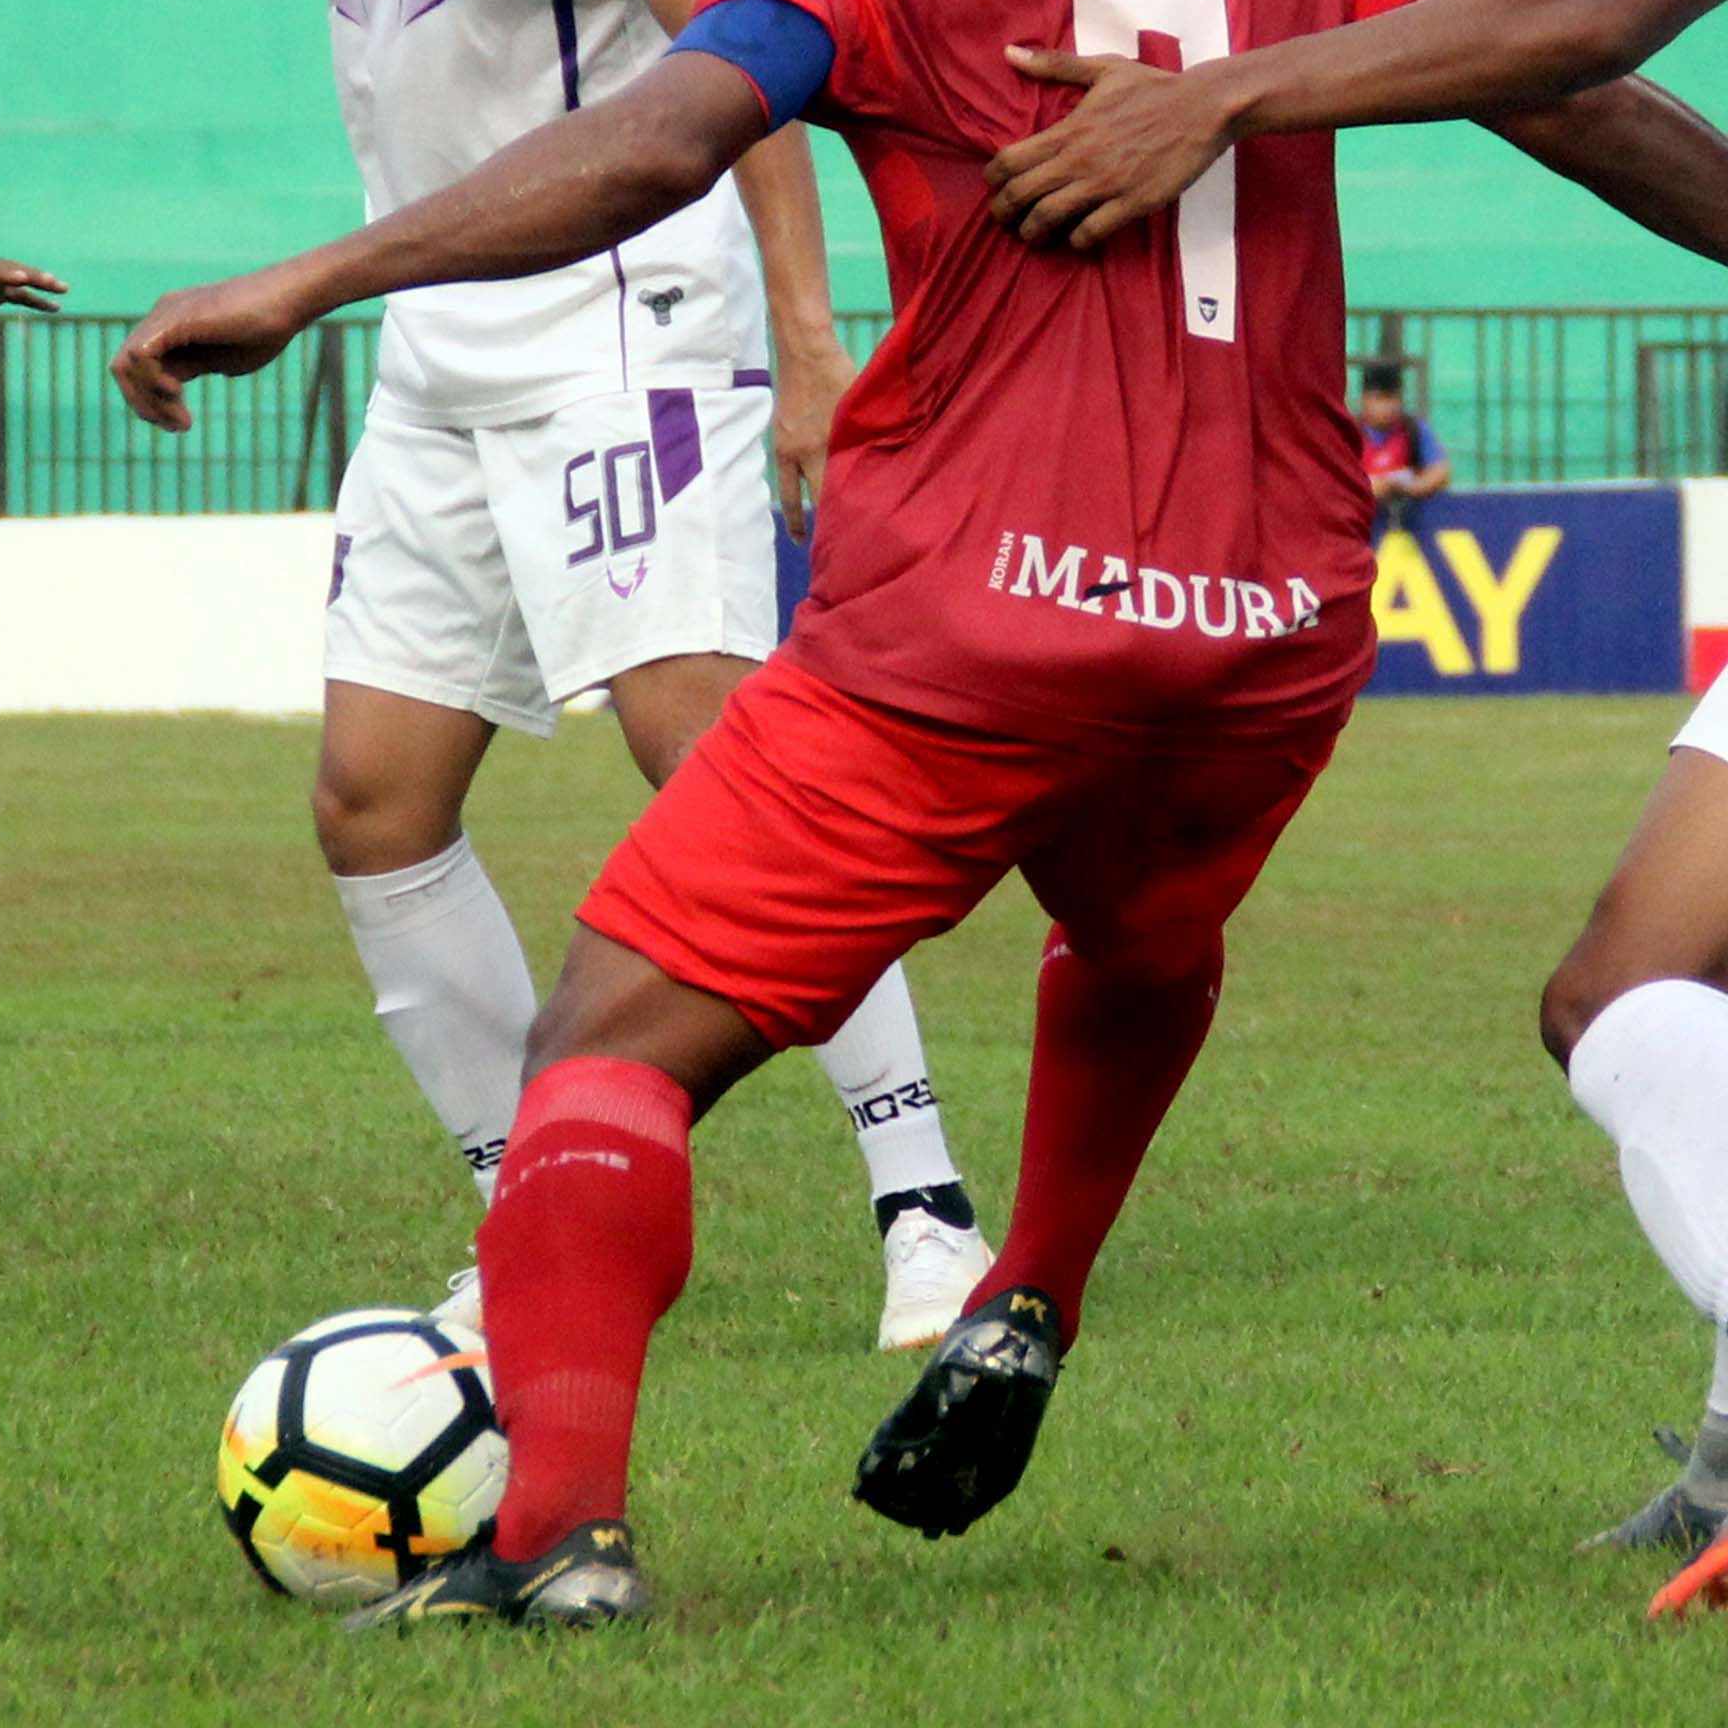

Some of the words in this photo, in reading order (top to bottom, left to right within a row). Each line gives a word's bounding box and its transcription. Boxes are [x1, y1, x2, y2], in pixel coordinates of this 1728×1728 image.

[563, 440, 657, 570] 50
[988, 530, 1015, 592] KORAN
[1009, 533, 1322, 639] MADURA
